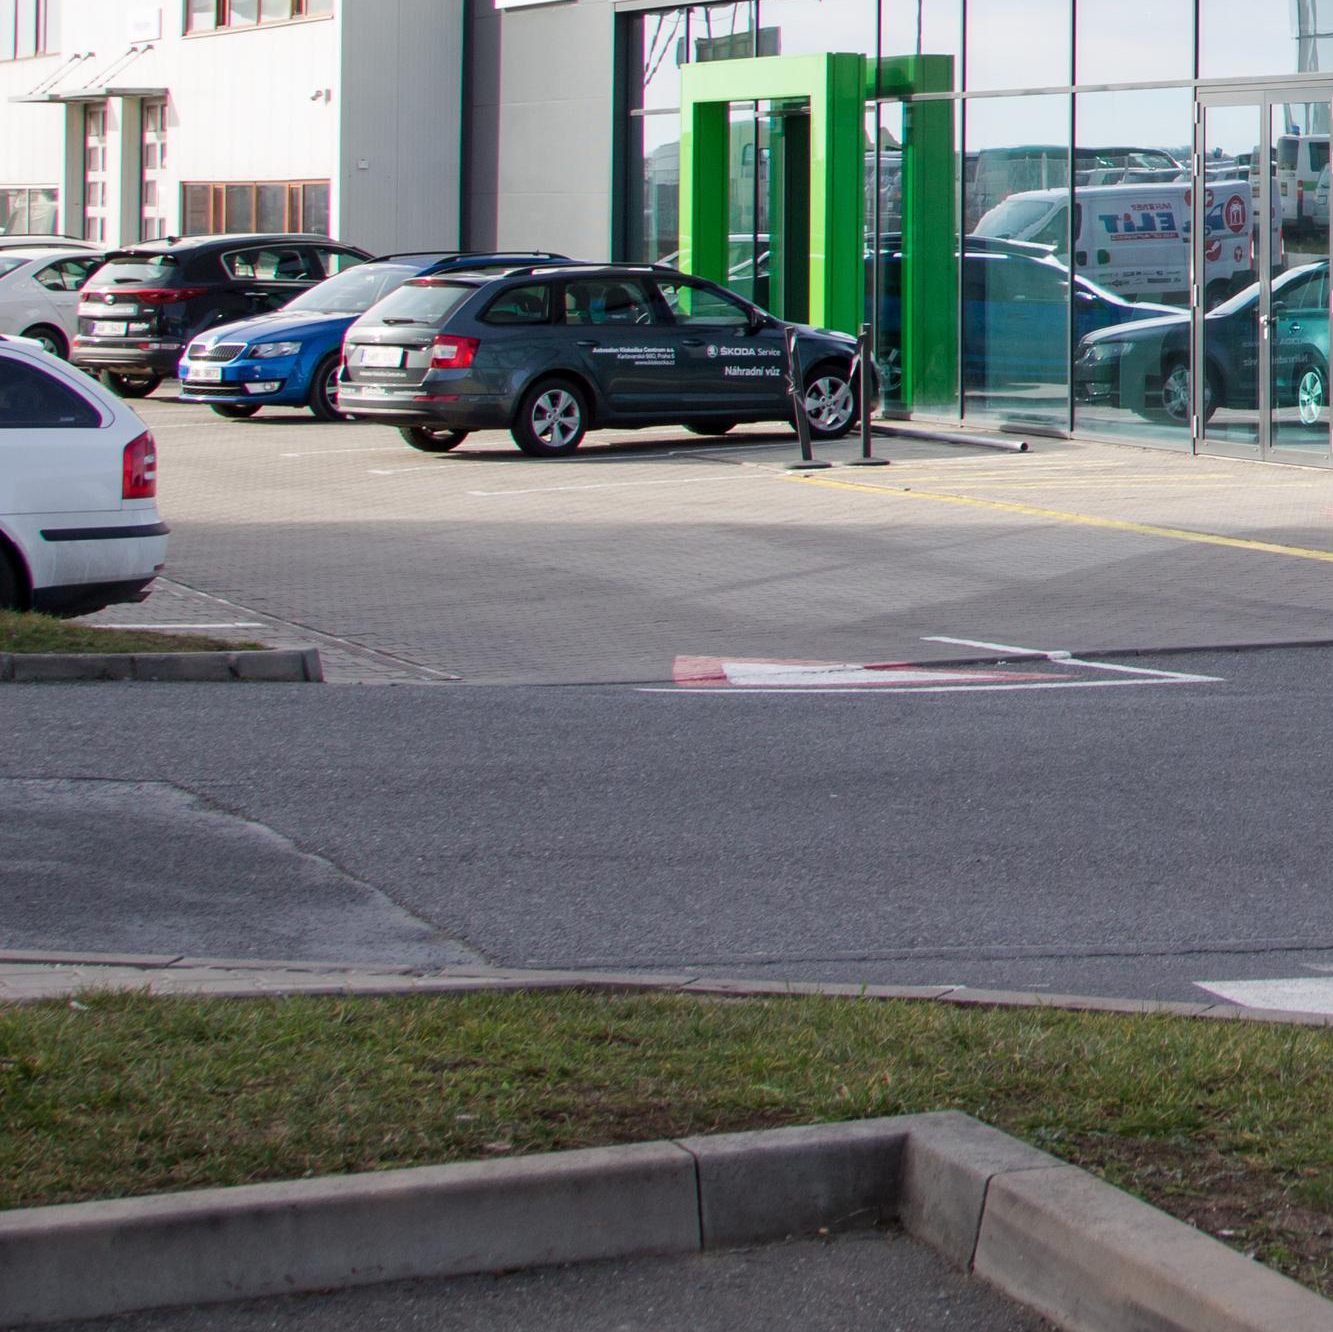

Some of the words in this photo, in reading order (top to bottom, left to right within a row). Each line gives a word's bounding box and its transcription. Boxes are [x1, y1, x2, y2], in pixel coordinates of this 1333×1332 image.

[720, 346, 755, 356] ŠKODA
[758, 348, 781, 356] Service
[725, 365, 764, 376] Náhradní
[765, 365, 781, 376] vůz
